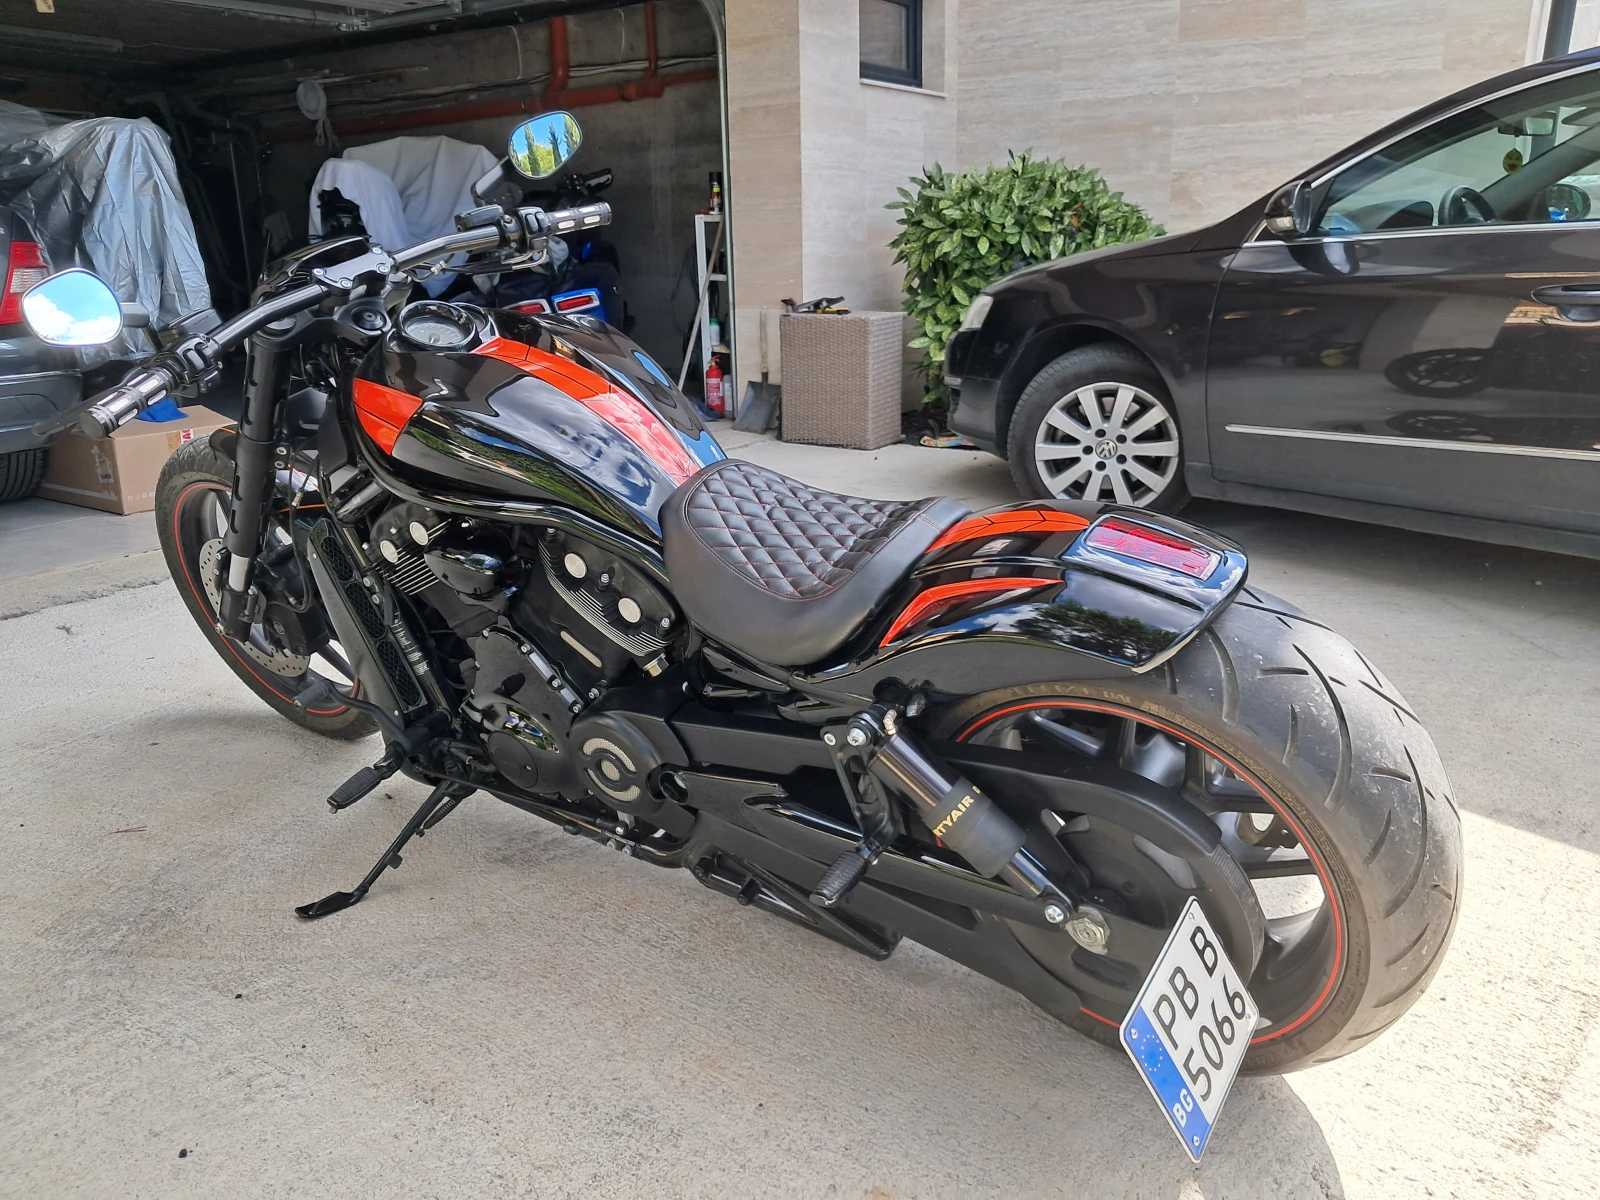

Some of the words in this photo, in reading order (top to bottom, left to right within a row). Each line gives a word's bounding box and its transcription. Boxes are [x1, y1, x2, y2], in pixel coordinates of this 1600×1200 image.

[1152, 966, 1199, 1051] PB
[1190, 926, 1218, 977] B
[1183, 974, 1246, 1102] 5066
[1172, 1088, 1194, 1128] BG
